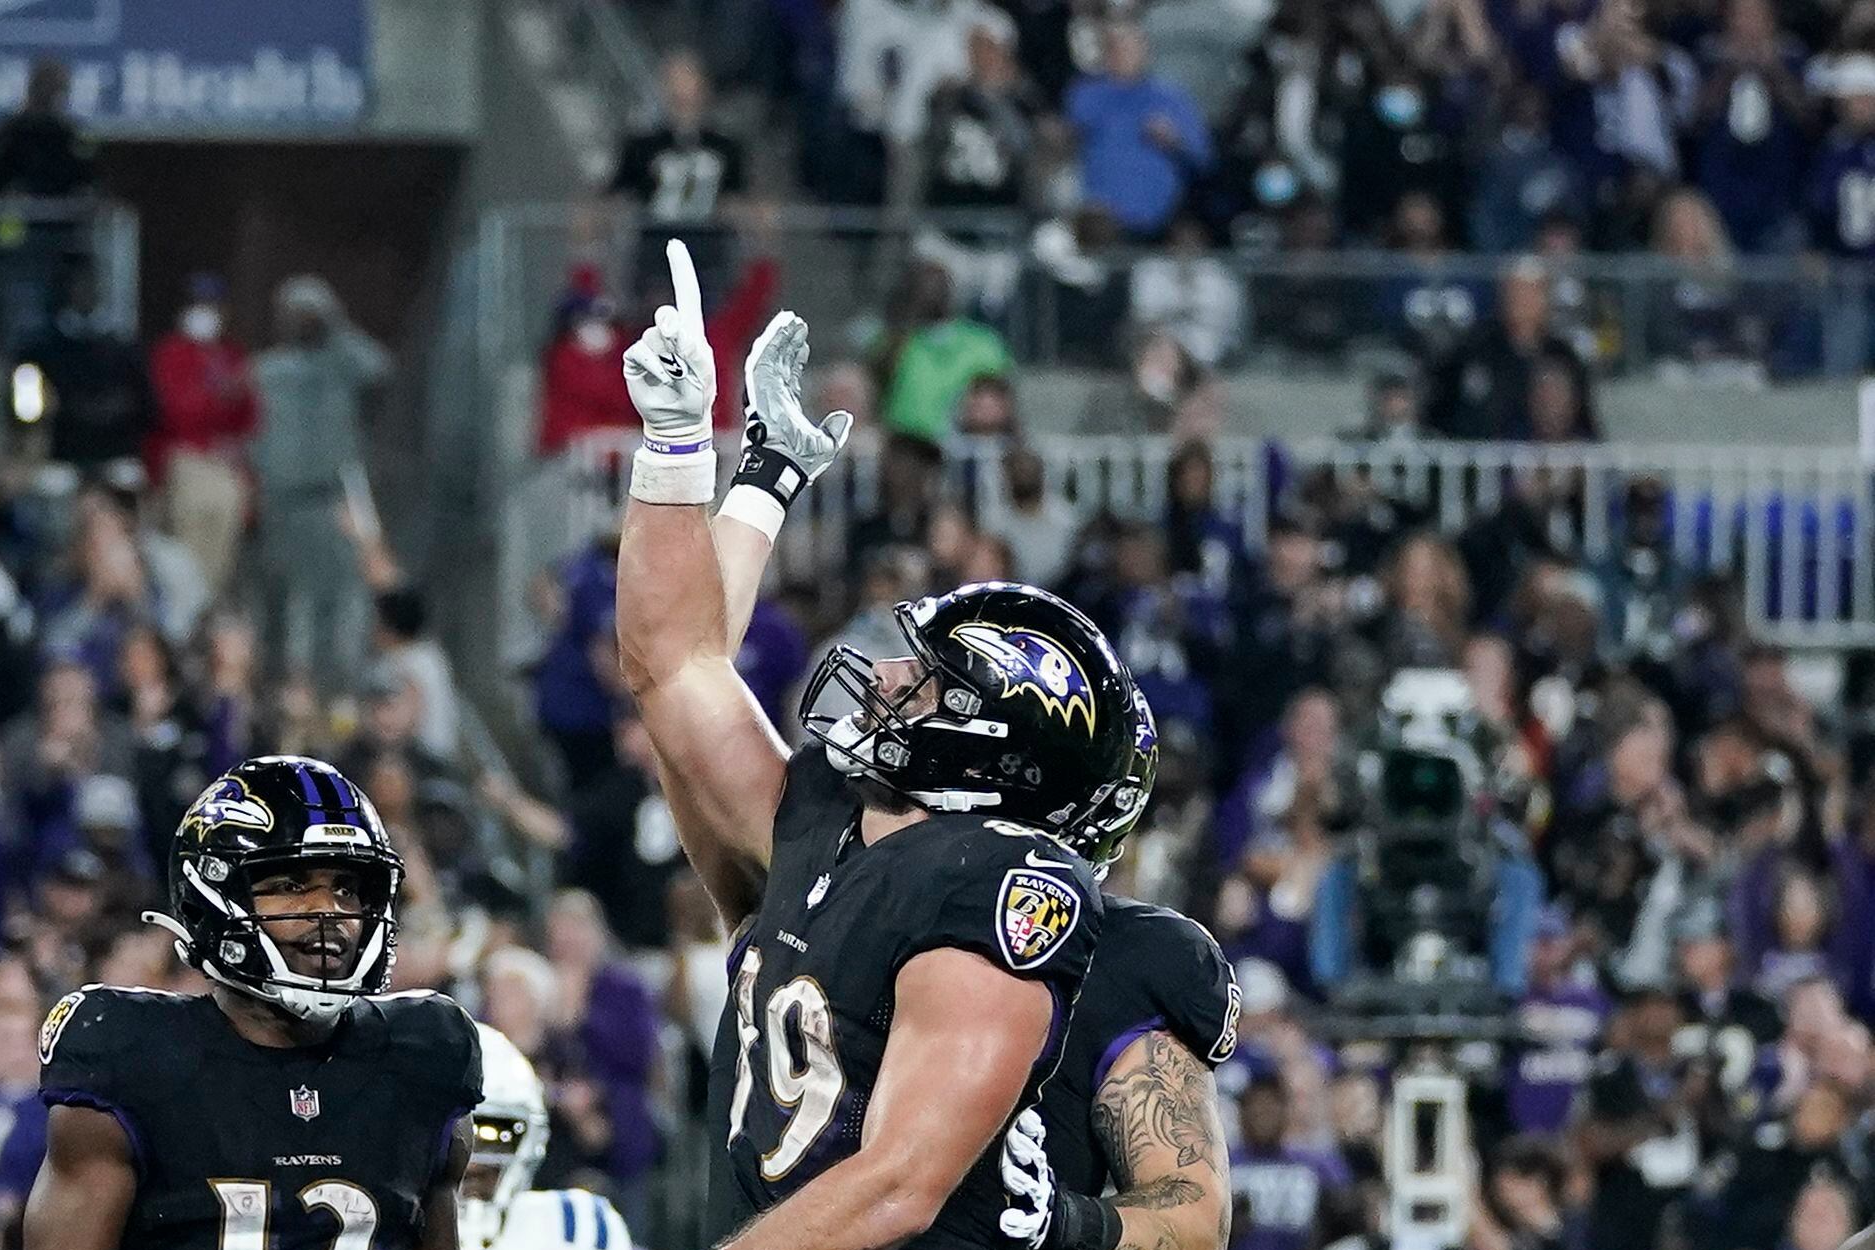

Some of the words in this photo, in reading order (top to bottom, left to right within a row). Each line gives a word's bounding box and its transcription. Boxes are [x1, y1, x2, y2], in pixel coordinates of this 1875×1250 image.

[124, 46, 367, 118] Health
[642, 438, 671, 453] ENS
[1014, 876, 1072, 908] RAVENS
[776, 929, 809, 953] RAVENS
[272, 1154, 342, 1166] RAVENS
